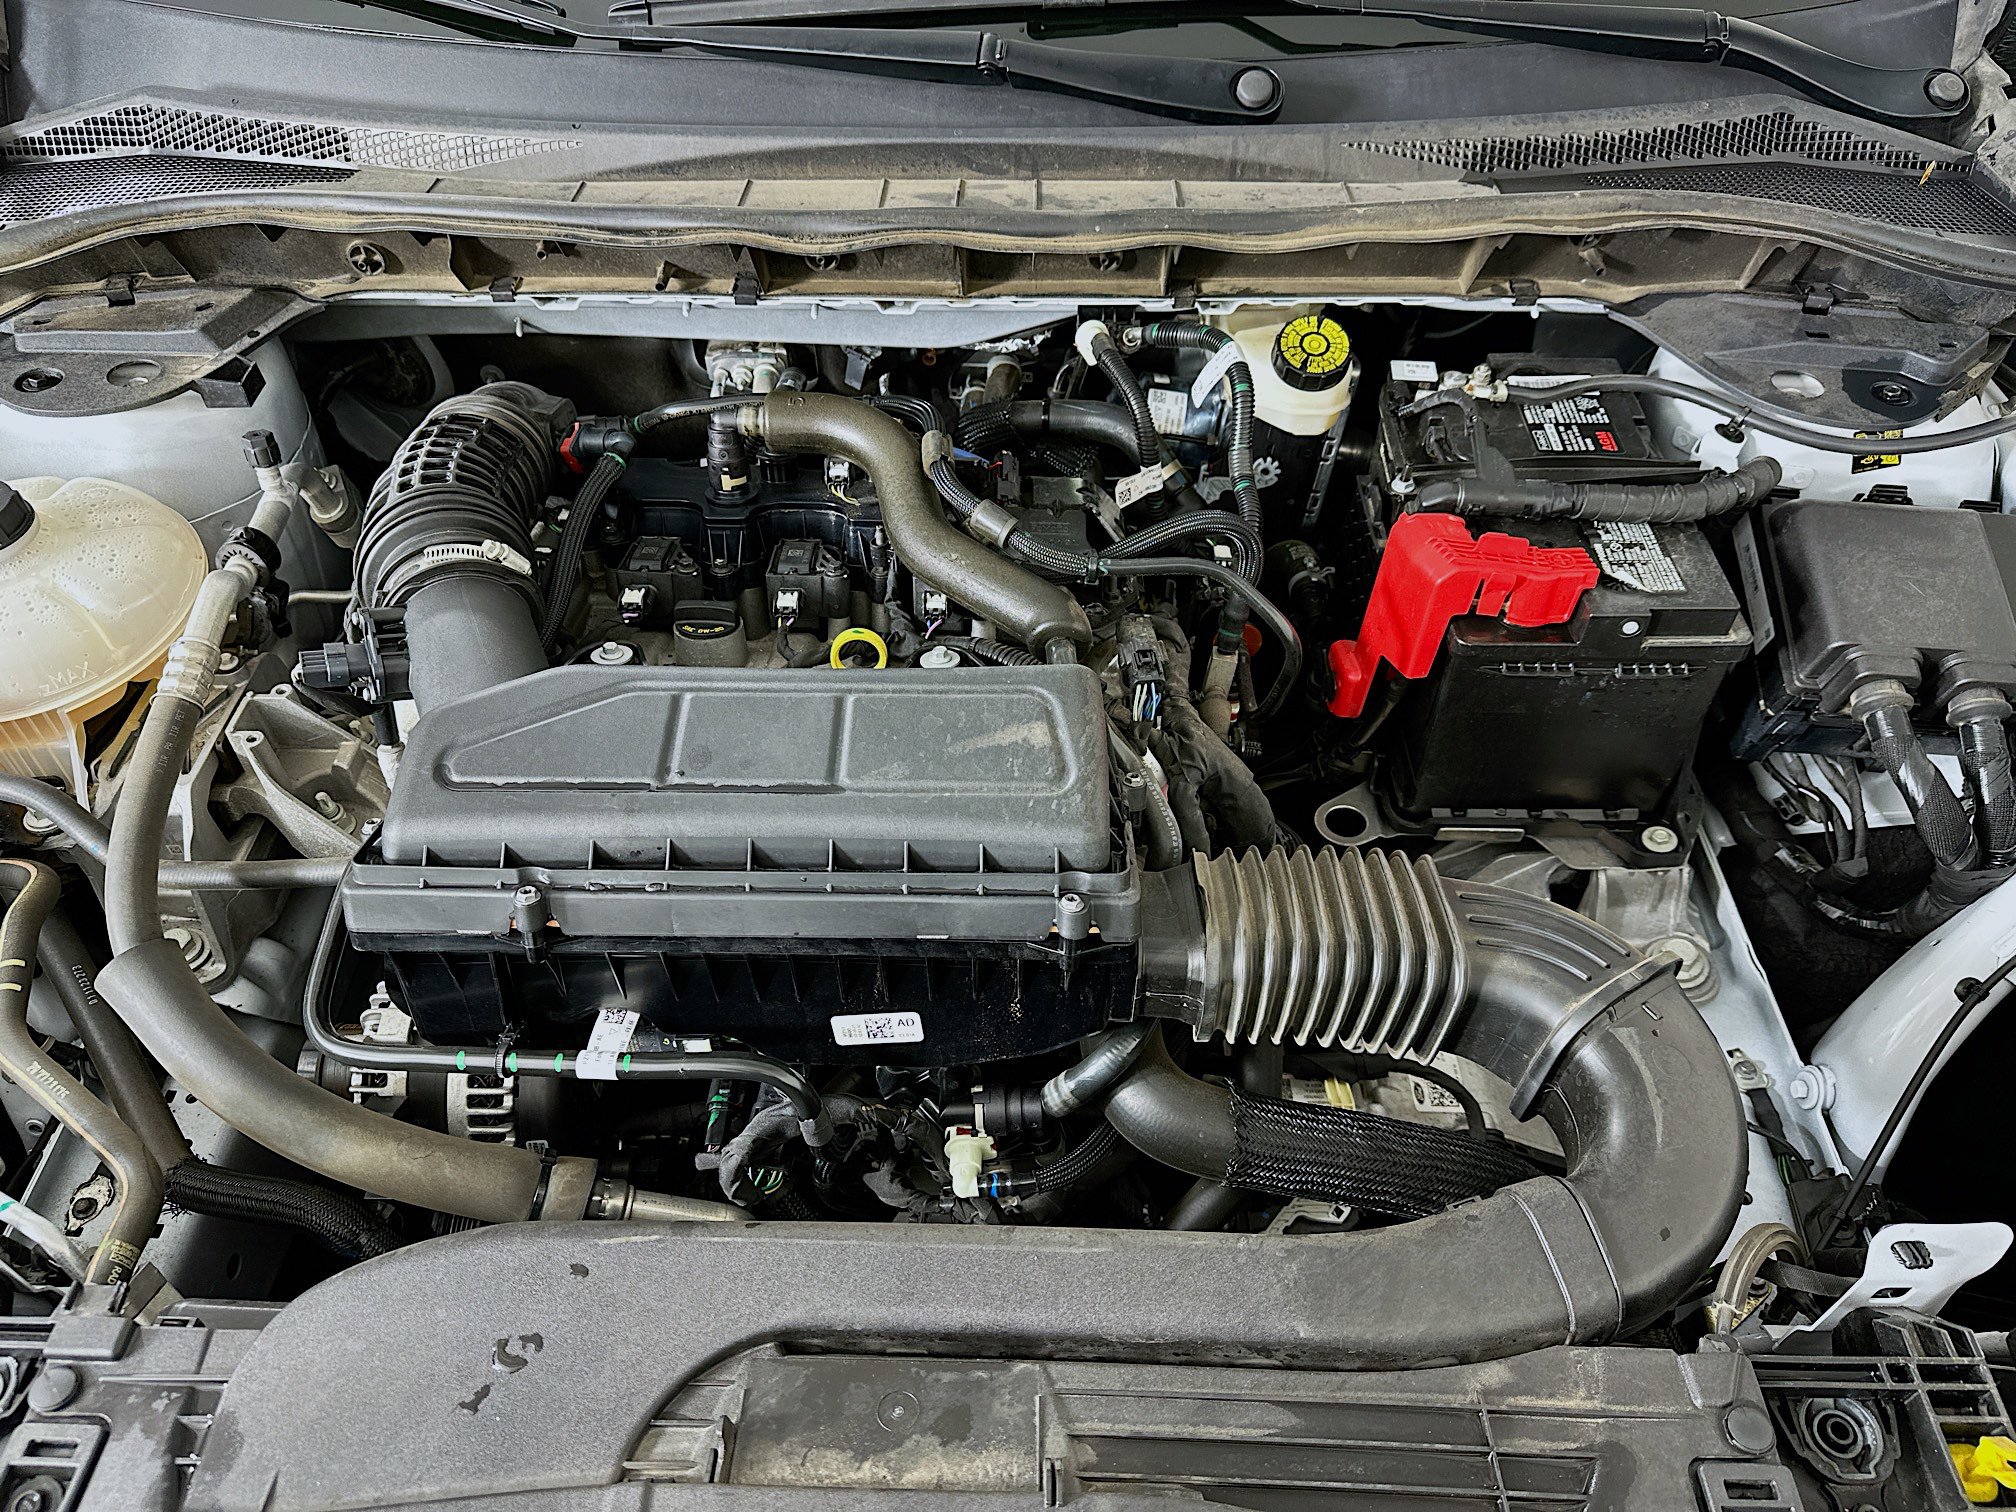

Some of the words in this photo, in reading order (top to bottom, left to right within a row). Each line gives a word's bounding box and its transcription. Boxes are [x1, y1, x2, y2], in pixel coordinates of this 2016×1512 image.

[1595, 431, 1615, 451] AGM
[48, 661, 98, 689] MAX
[897, 1018, 915, 1027] AD
[107, 1265, 123, 1285] RAD
